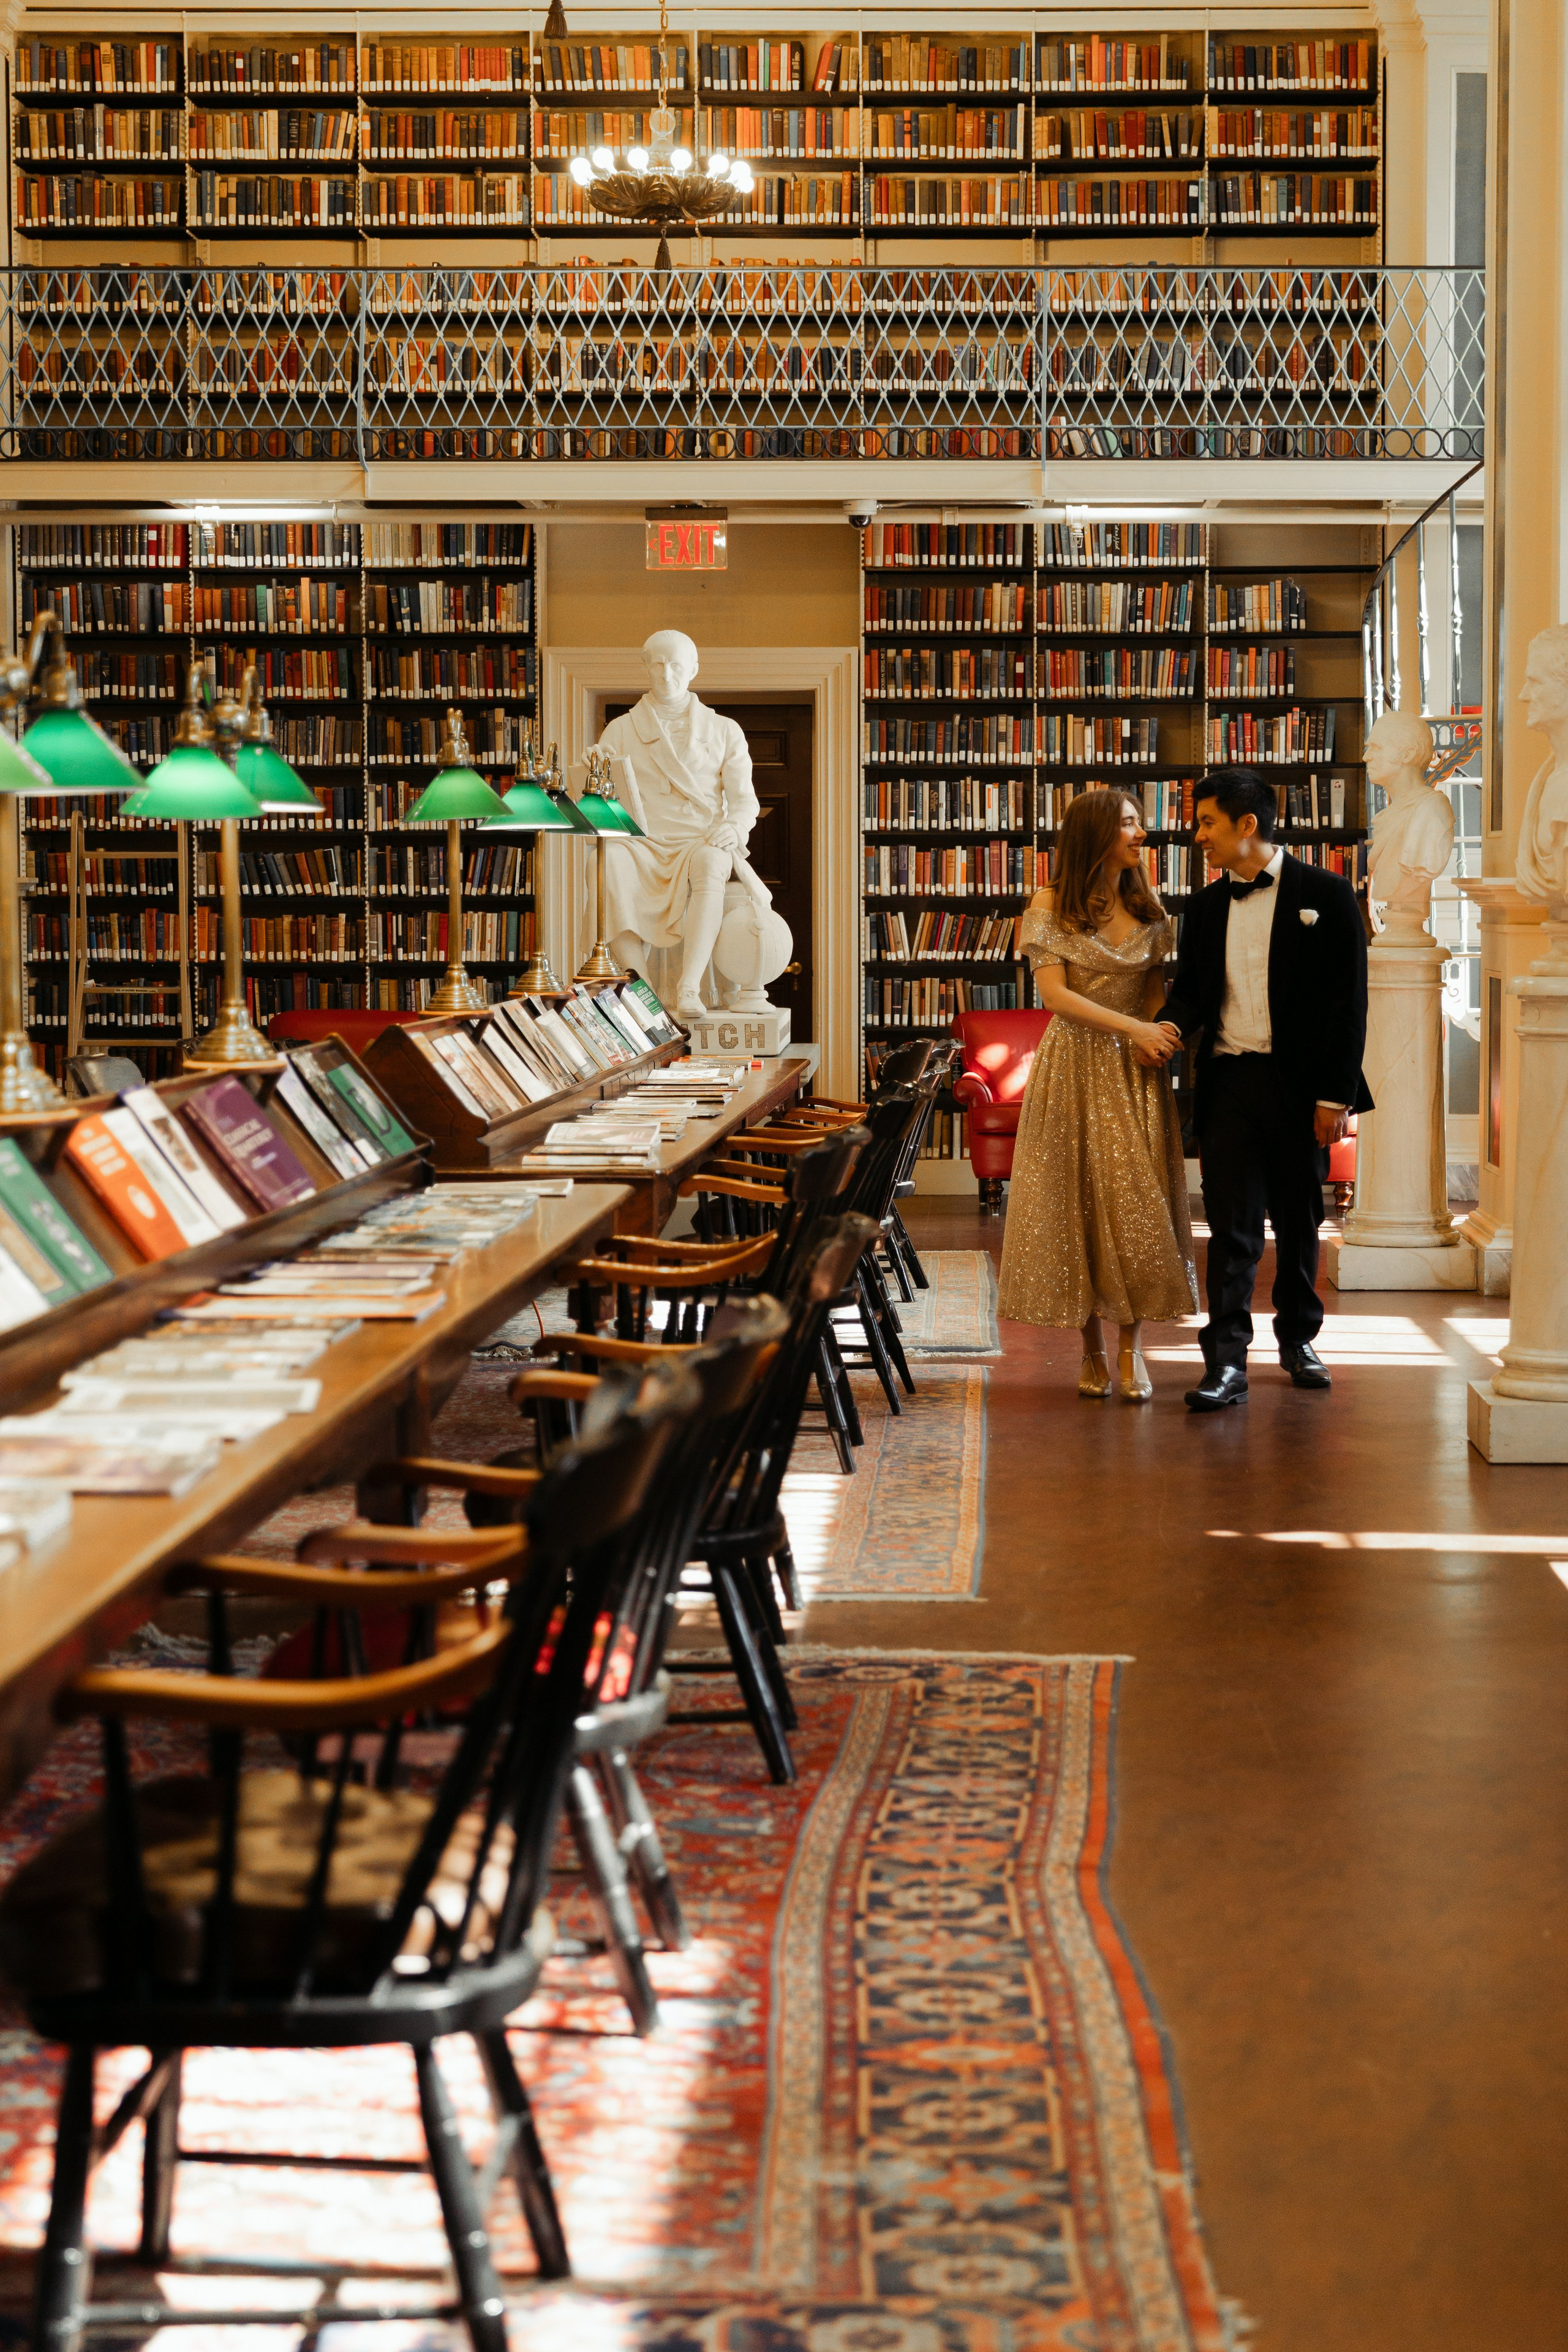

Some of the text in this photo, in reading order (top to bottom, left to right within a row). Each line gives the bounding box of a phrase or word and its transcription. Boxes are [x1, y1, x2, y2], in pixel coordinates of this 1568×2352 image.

[659, 524, 719, 564] EXIT
[637, 986, 649, 997] AFRICAN
[639, 990, 653, 1001] AMERICAN
[681, 1023, 766, 1049] TCH
